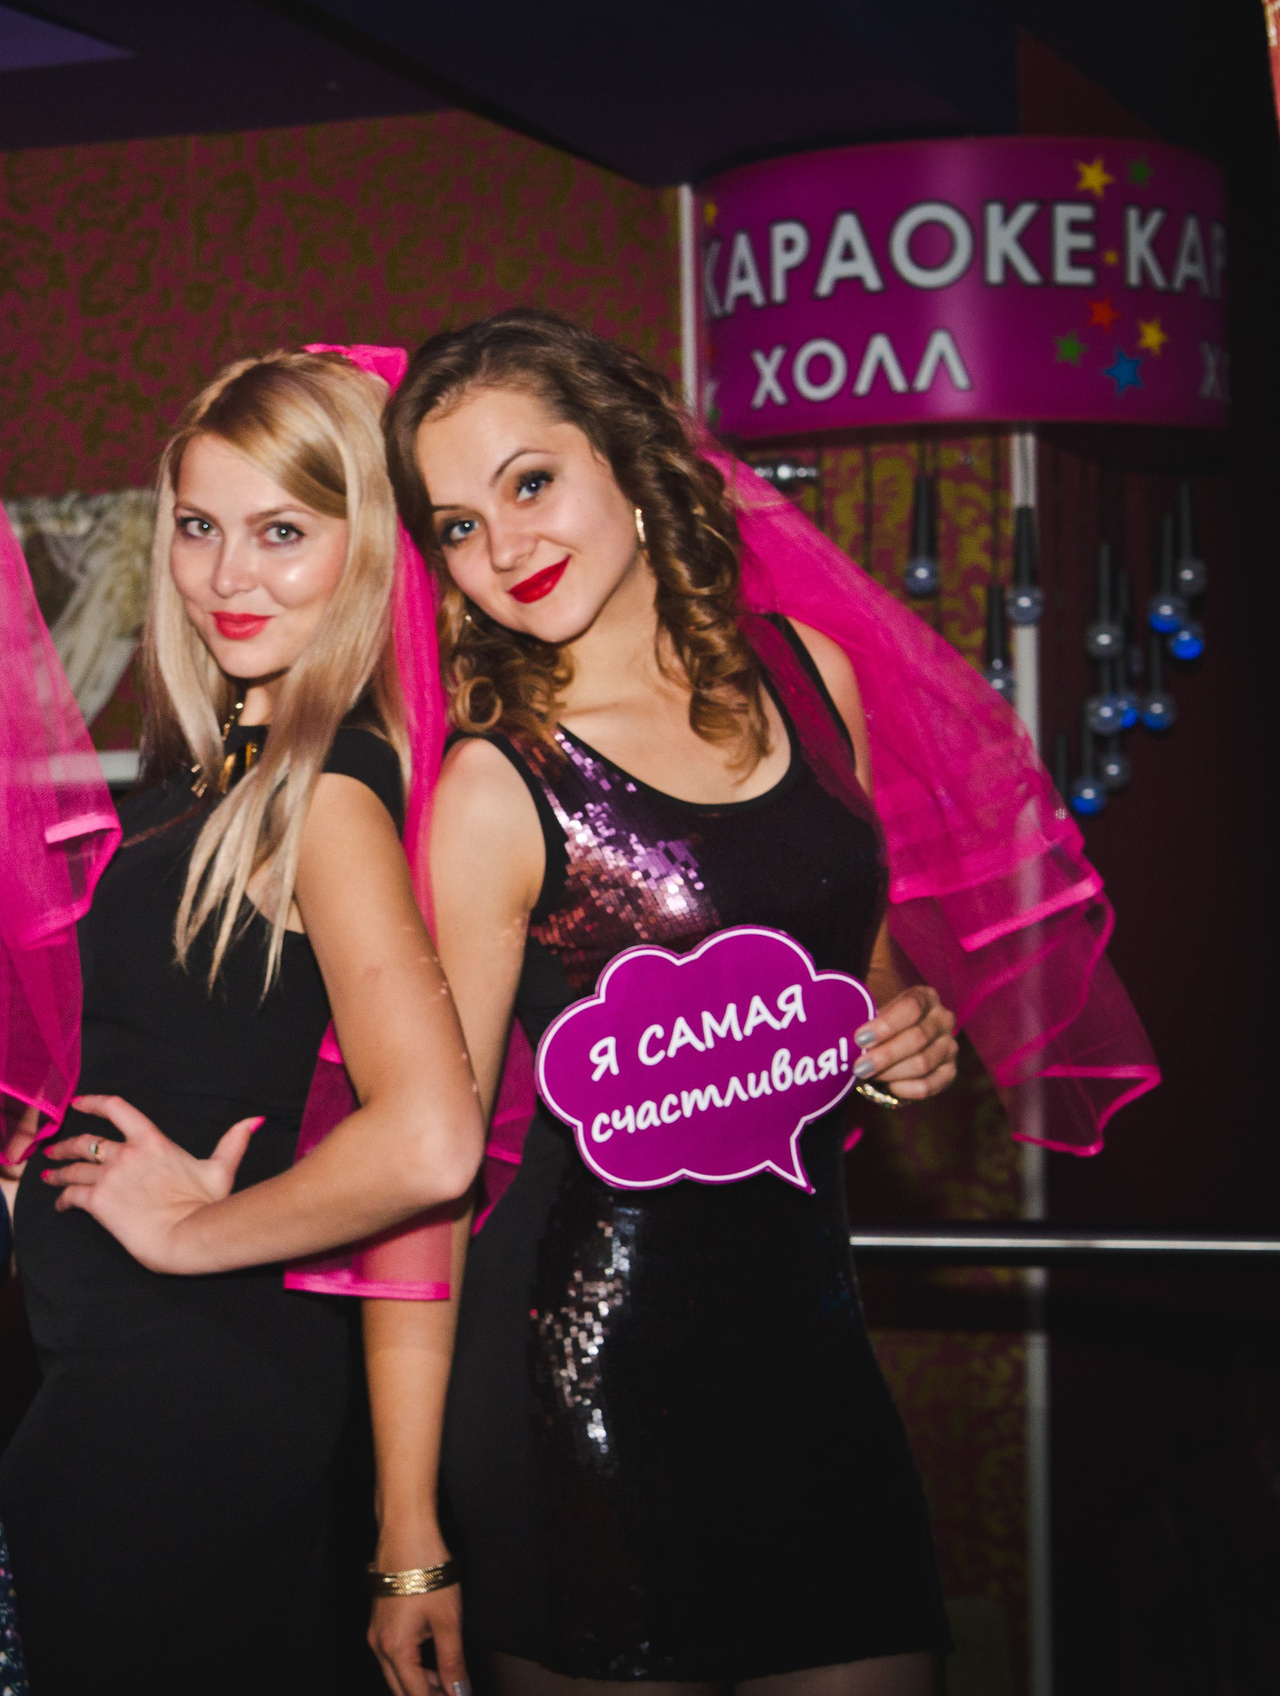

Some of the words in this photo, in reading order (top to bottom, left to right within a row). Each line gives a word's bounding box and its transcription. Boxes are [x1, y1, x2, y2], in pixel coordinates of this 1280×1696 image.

[751, 330, 972, 410] ХОЛЛ
[588, 1035, 620, 1082] Я
[637, 983, 808, 1067] САМАЯ
[591, 1036, 850, 1144] счастливая!
